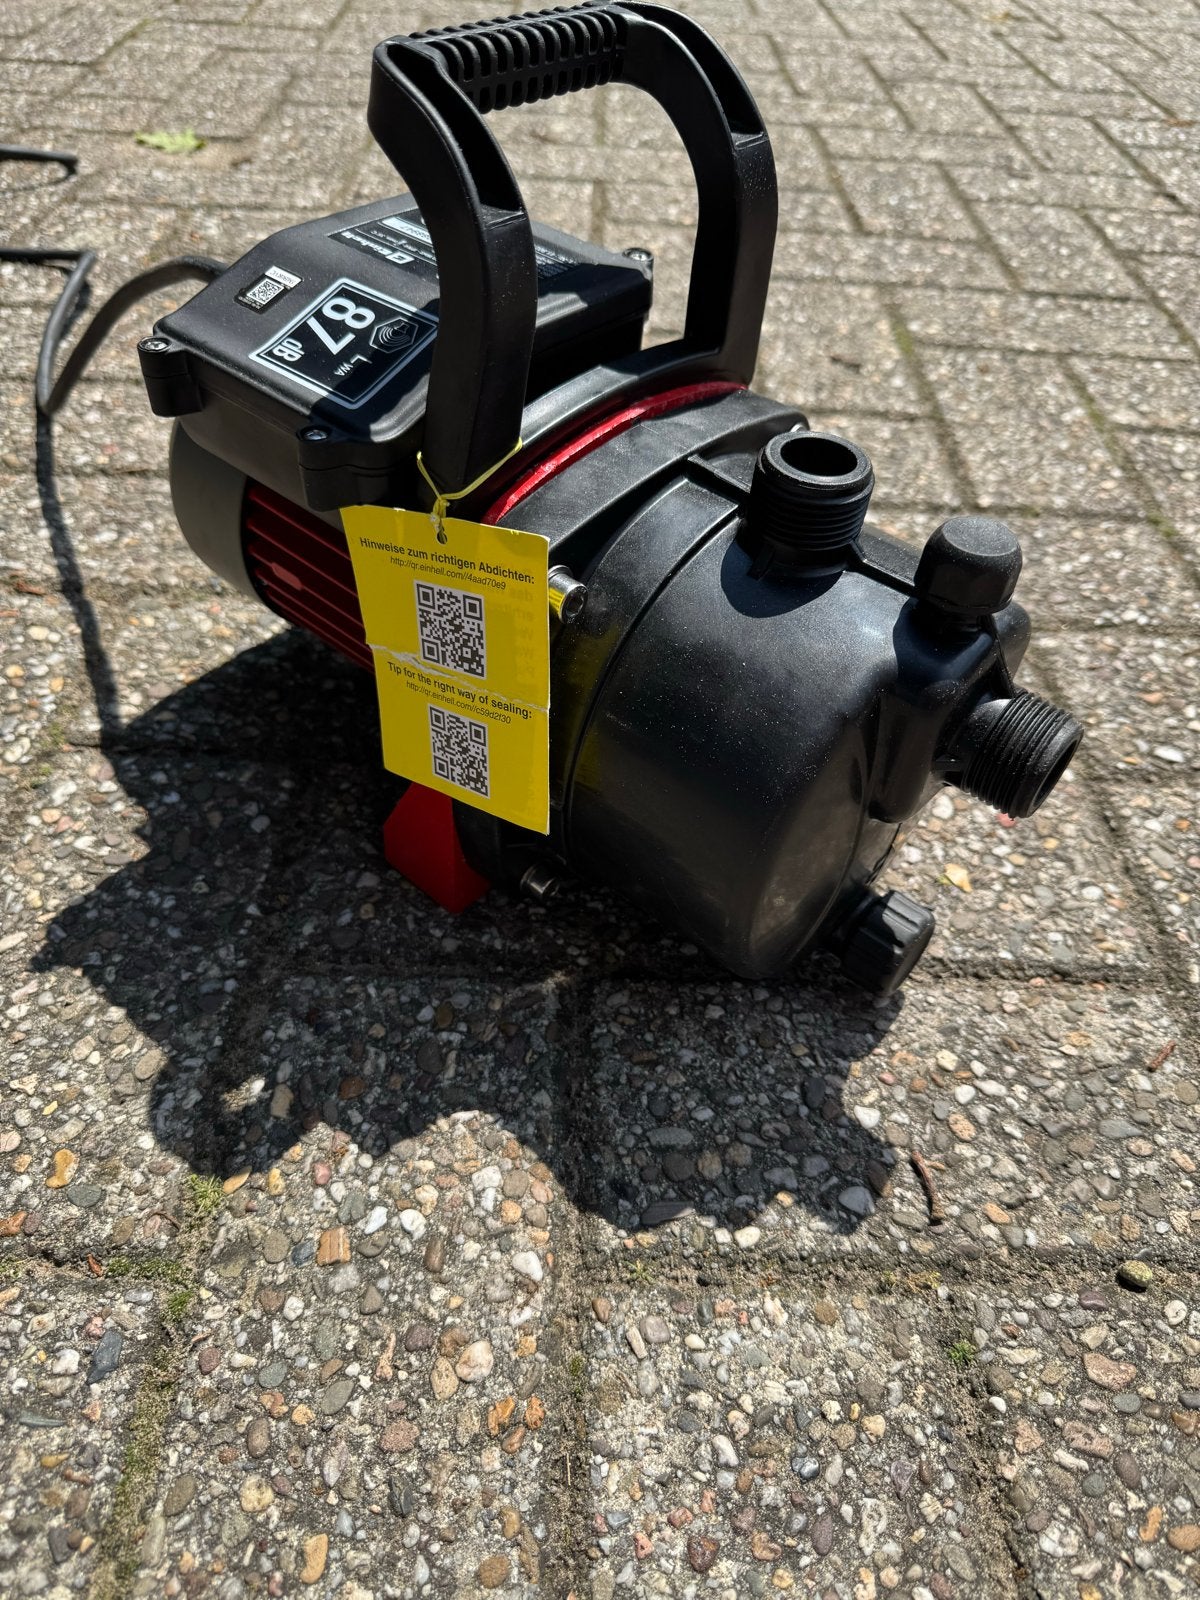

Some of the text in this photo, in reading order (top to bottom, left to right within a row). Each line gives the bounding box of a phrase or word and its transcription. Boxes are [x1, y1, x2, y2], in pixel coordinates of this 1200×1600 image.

[272, 296, 376, 362] 87 dB
[360, 537, 535, 584] Hinweise zum richtigen Abdichten:
[387, 661, 532, 720] Tip for the right way of sealing:
